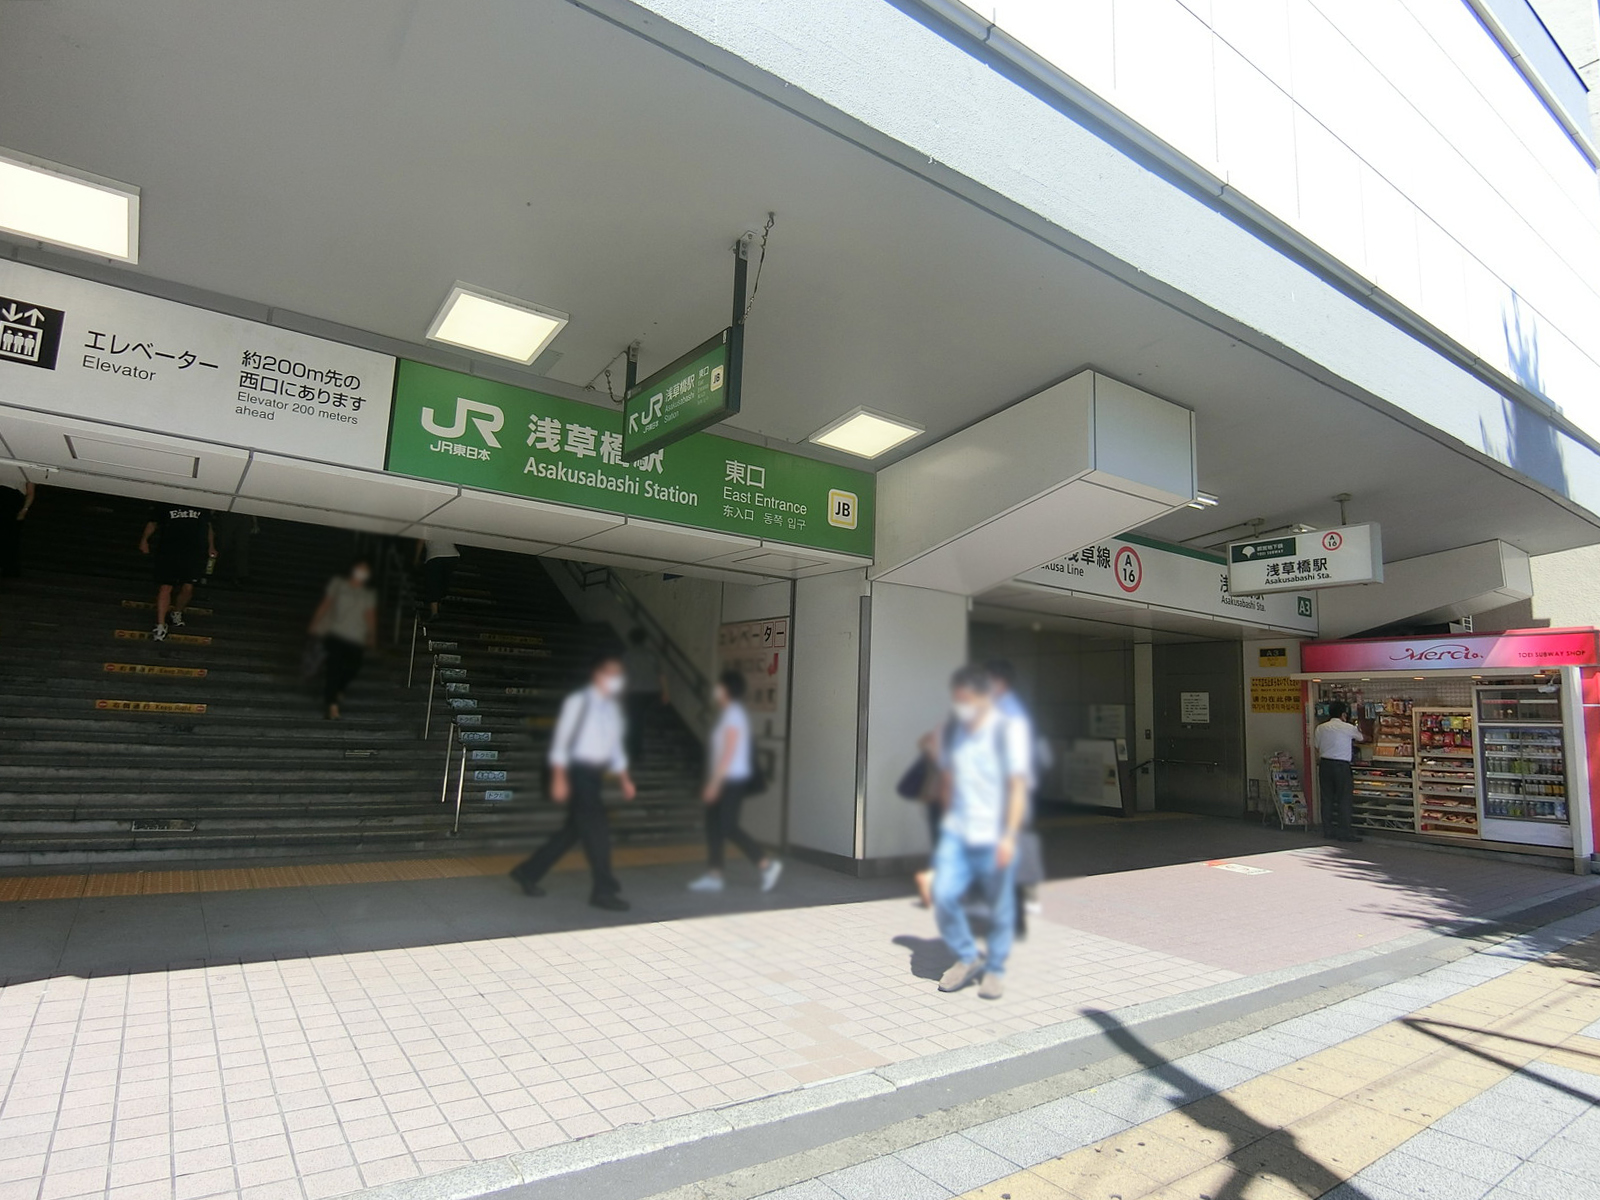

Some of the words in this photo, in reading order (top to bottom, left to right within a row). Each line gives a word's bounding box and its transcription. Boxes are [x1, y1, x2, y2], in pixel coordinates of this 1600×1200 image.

[84, 330, 219, 370] エレベーター
[82, 355, 157, 382] Elevator
[241, 350, 361, 391] 約200m先の
[239, 370, 367, 412] 西口にあります
[235, 405, 276, 421] ahead
[237, 391, 289, 411] Elevator
[292, 402, 316, 416] 200
[318, 409, 359, 425] meters
[641, 392, 663, 425] JR
[421, 397, 504, 449] JR
[429, 440, 491, 462] JR東日本
[523, 456, 640, 496] Asakusabashi
[644, 480, 699, 507] Station
[725, 460, 765, 489] 東口
[723, 486, 752, 504] East
[755, 493, 808, 515] Entrance
[835, 501, 851, 517] JB
[723, 505, 754, 521] 东入口
[1067, 563, 1084, 577] Line
[1125, 554, 1133, 567] A
[1266, 557, 1328, 577] 浅草橋駅
[1123, 568, 1136, 583] 16
[1265, 573, 1315, 585] Asakusabashi
[1221, 595, 1256, 610] Asakusabashi
[1256, 602, 1266, 612] Sta.
[1300, 600, 1310, 615] A3
